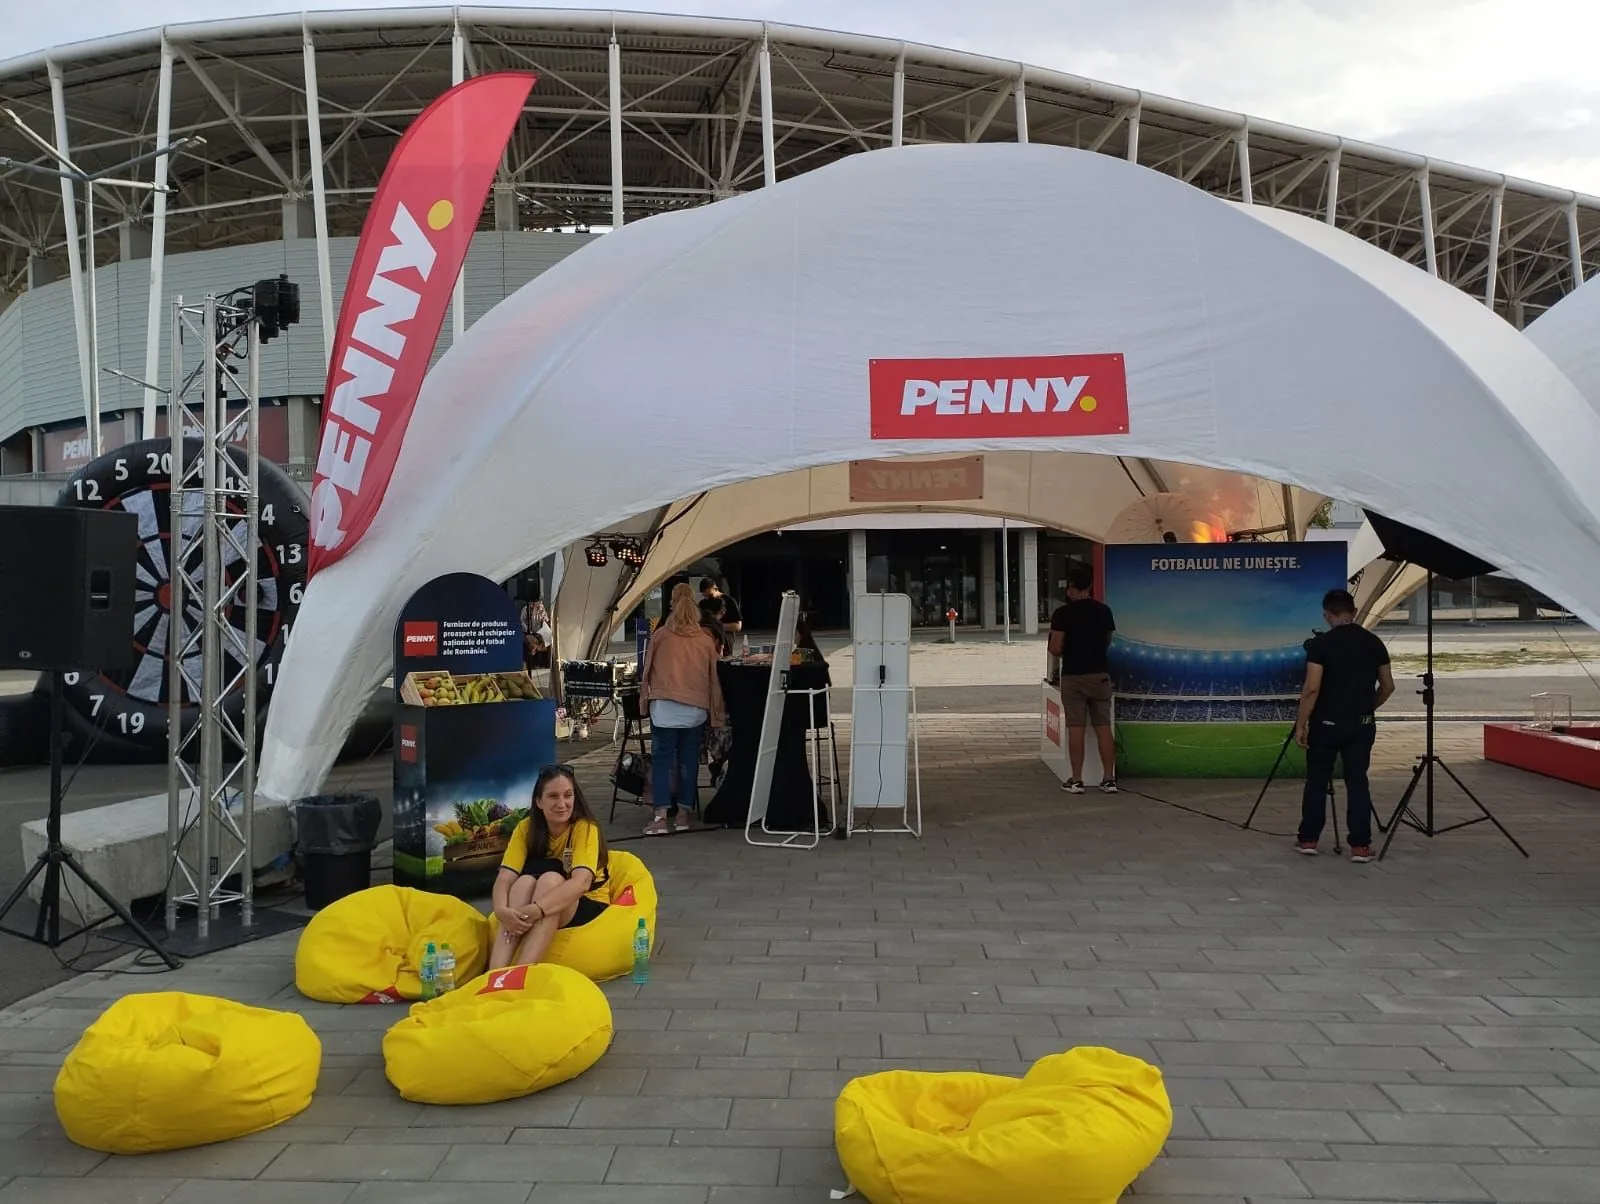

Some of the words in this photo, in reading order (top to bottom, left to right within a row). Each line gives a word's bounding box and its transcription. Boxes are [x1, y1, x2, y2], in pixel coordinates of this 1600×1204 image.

[114, 458, 129, 481] 5
[146, 452, 173, 475] 20
[73, 479, 103, 501] 12
[261, 503, 276, 526] 4
[276, 543, 303, 565] 13
[1151, 558, 1220, 571] FOTBALUL
[1223, 557, 1242, 570] NE
[289, 582, 304, 604] 6
[443, 630, 477, 638] proaspete
[478, 629, 484, 637] al
[485, 628, 515, 637] echipelor
[472, 620, 480, 628] de
[481, 620, 508, 629] produse
[476, 638, 484, 646] de
[485, 637, 505, 646] fotbal
[89, 694, 105, 717] 7
[116, 711, 145, 735] 19
